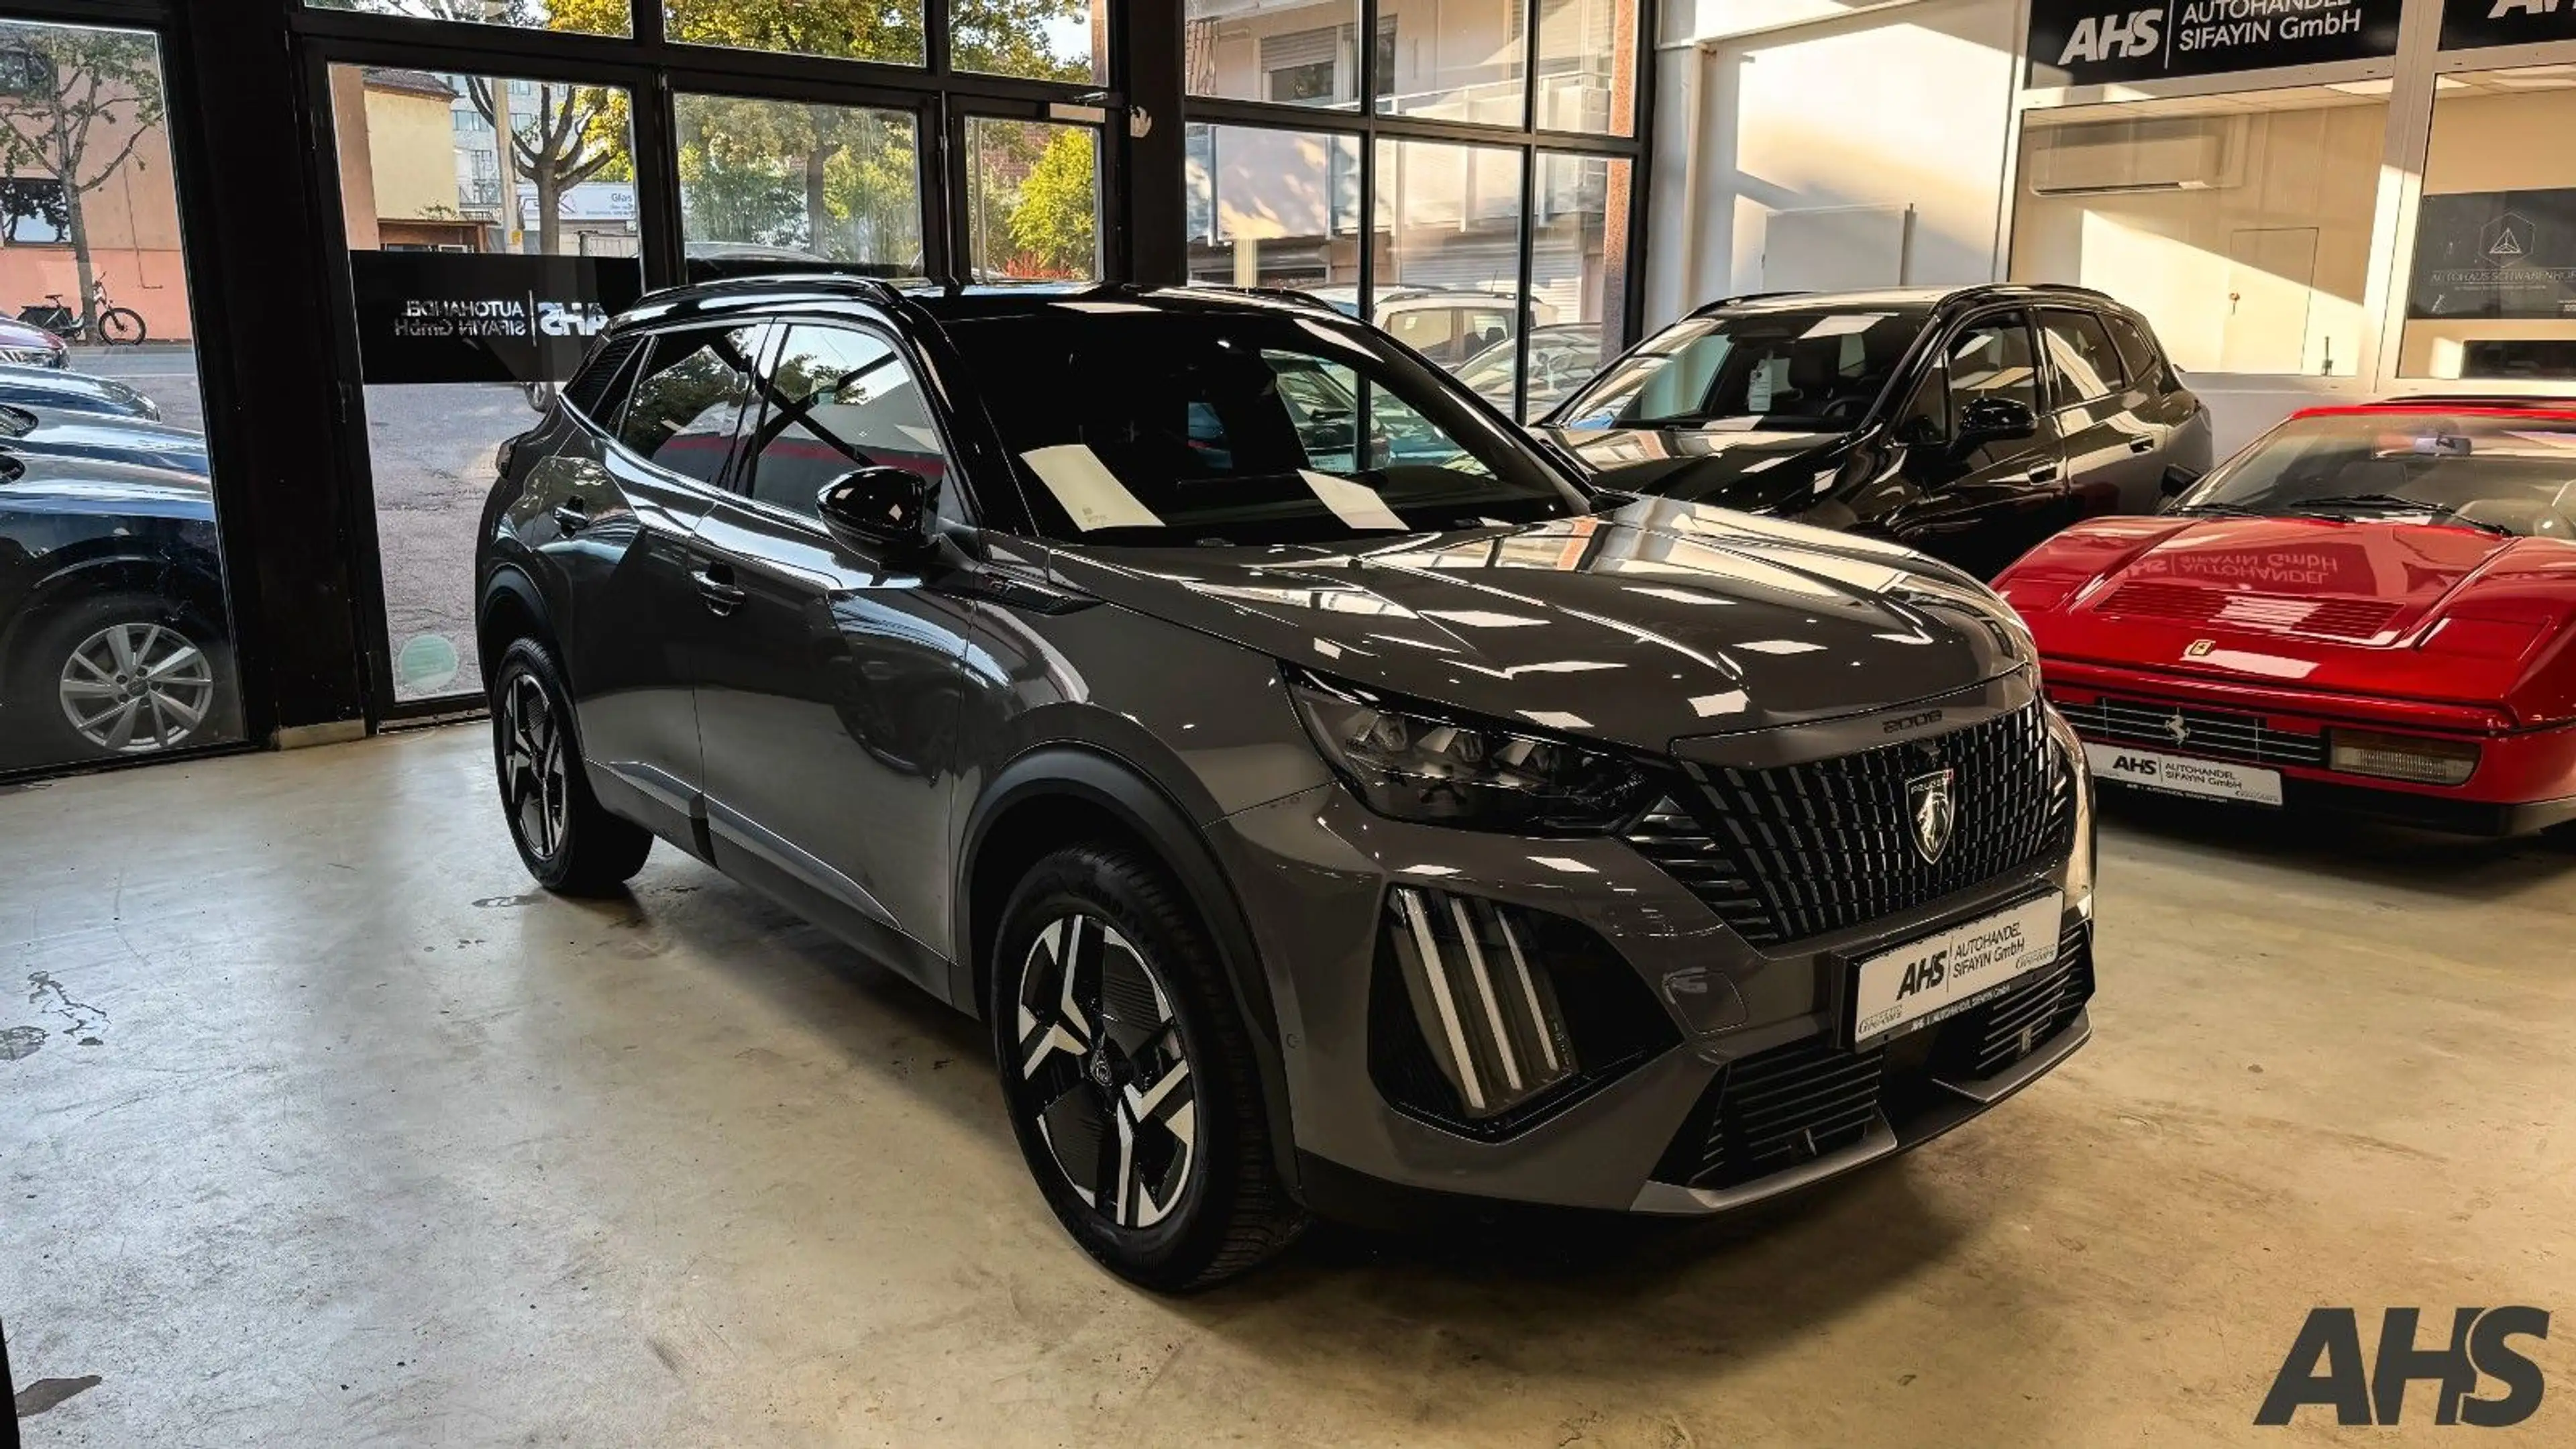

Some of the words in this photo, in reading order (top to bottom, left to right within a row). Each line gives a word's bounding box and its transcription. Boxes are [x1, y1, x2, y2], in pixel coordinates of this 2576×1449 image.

[2057, 9, 2163, 65] AHS
[2180, 19, 2271, 51] SIFAYIN
[2279, 8, 2361, 40] GmbH
[1882, 710, 1943, 734] 2008
[2113, 755, 2157, 775] AHS
[2165, 763, 2235, 780] AUTOHANDEL
[2208, 777, 2242, 790] GmbH
[1994, 937, 2025, 962] GmbH
[1896, 950, 1947, 1001] AHS
